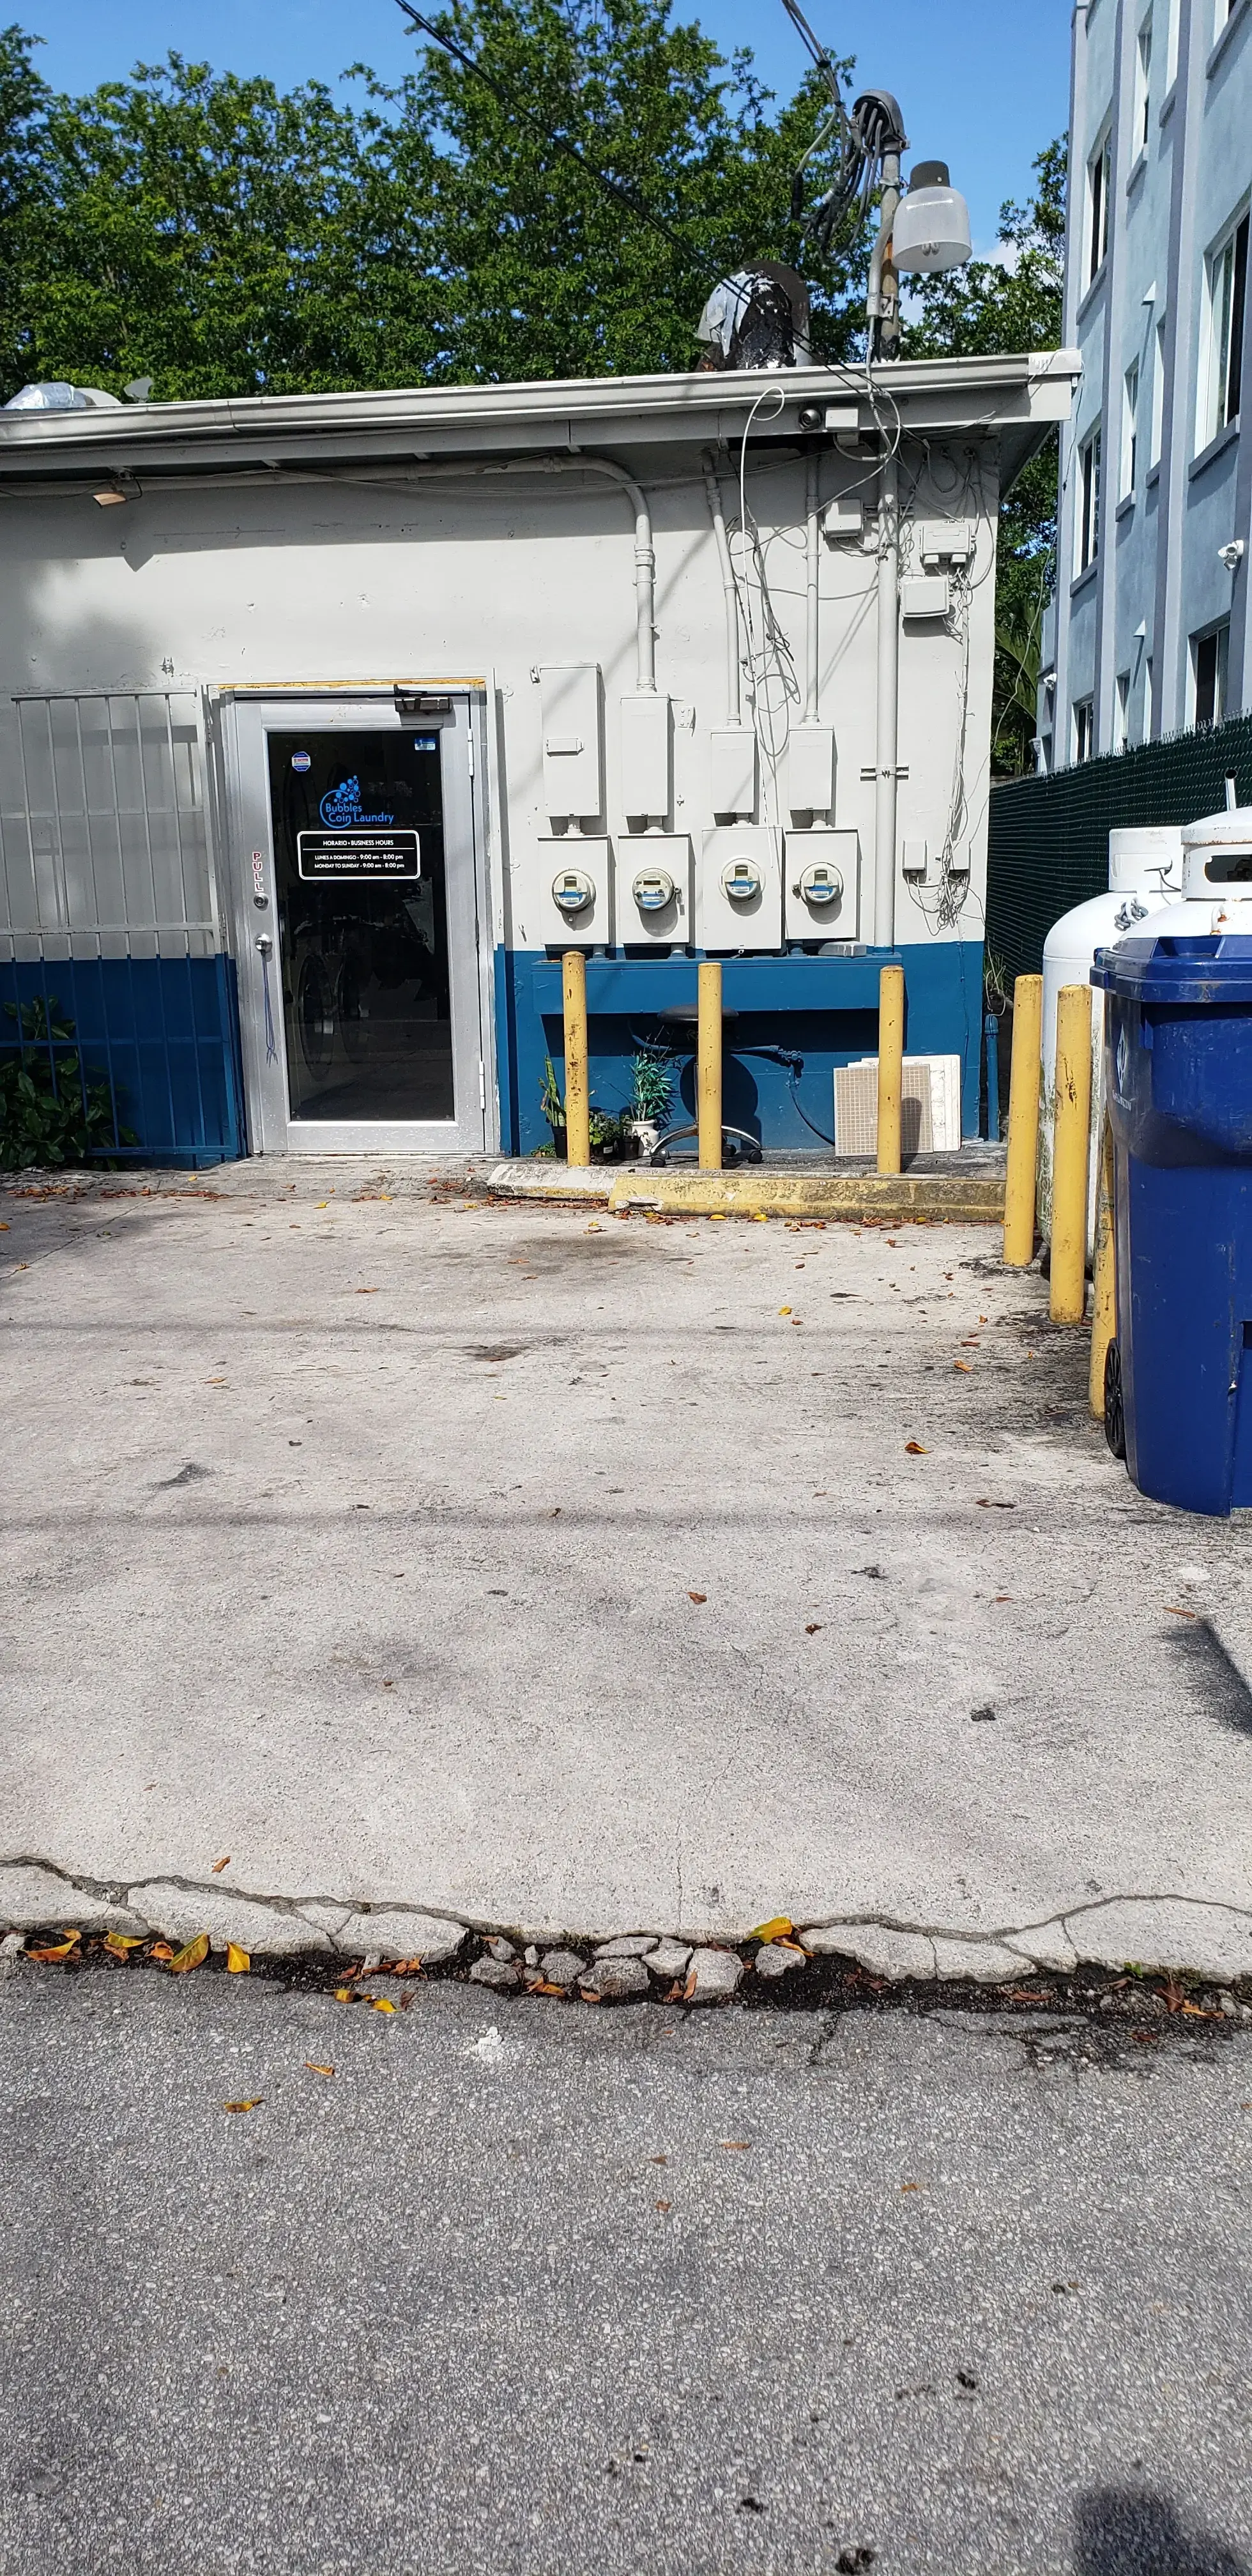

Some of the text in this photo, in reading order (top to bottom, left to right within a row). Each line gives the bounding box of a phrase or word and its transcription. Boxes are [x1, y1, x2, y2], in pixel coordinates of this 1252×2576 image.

[325, 803, 362, 813] Bubbles
[328, 811, 394, 824] Coin Laundry
[252, 851, 264, 893] PULL
